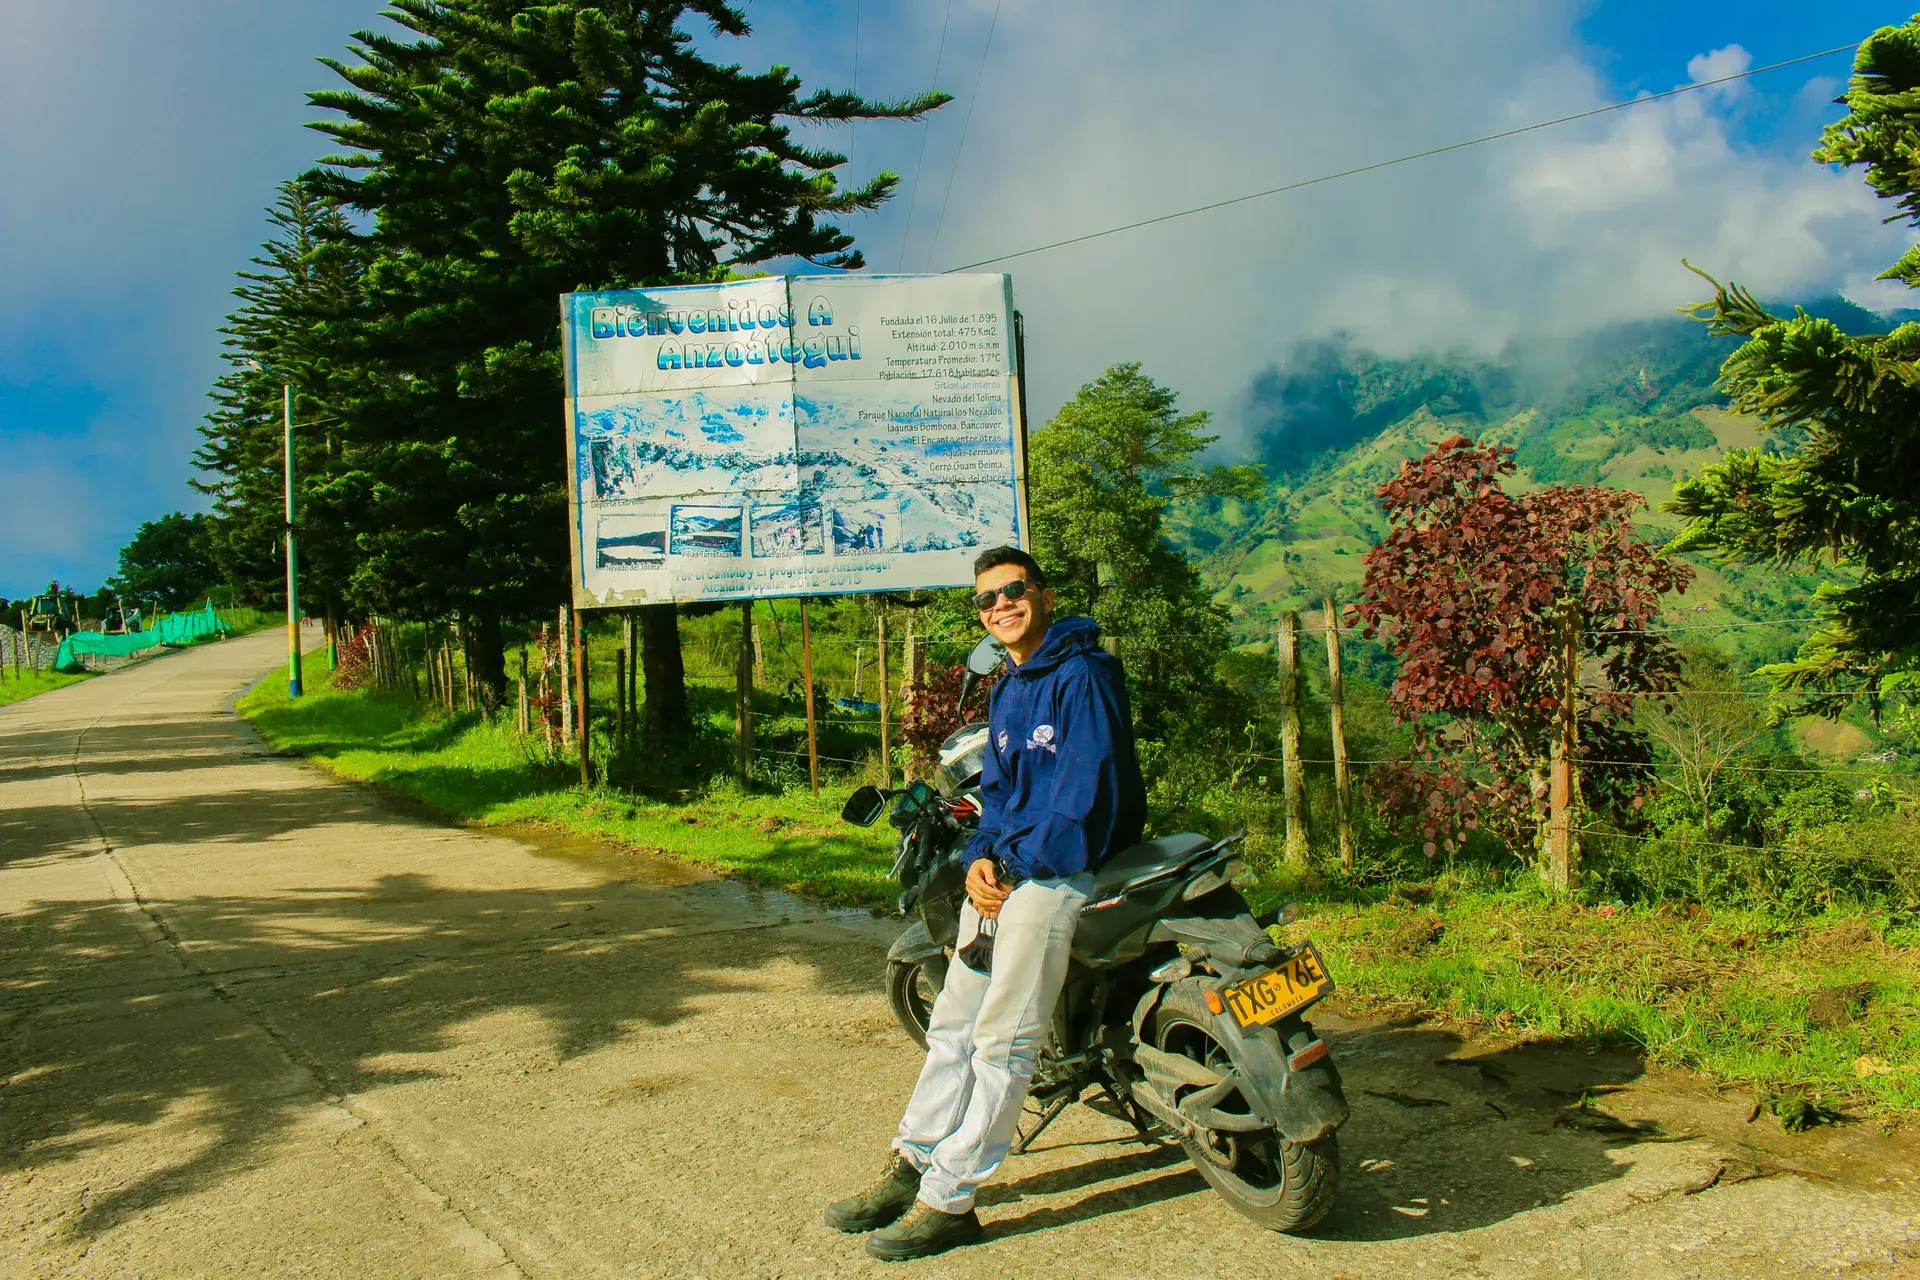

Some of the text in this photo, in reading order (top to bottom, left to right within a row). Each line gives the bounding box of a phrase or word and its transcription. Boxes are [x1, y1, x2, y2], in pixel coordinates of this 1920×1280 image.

[592, 294, 834, 339] Bienvenidos A
[880, 313, 997, 326] Fundada el 16 Julio de 1.895
[892, 326, 997, 340] Extensión total: 475 Km2
[656, 325, 862, 370] Anzoátegui
[906, 342, 939, 352] Altitud:
[940, 340, 968, 351] 2.010
[886, 355, 937, 369] Temperatura
[938, 353, 978, 365] Promedio:
[934, 381, 959, 390] Sitios
[932, 394, 961, 404] Nevado
[962, 393, 975, 403] del
[858, 410, 886, 423] Parque
[887, 409, 922, 419] Nacional
[923, 407, 954, 418] Natural
[968, 406, 1002, 416] Nevados
[887, 423, 918, 435] lagunas
[912, 436, 920, 445] El
[921, 435, 955, 445] Encanto
[957, 435, 977, 444] entre
[941, 447, 1005, 460] Aguas termales
[929, 461, 952, 472] Cerro
[1228, 952, 1324, 1020] TXG 76E
[1270, 995, 1304, 1016] COLOMBIA
